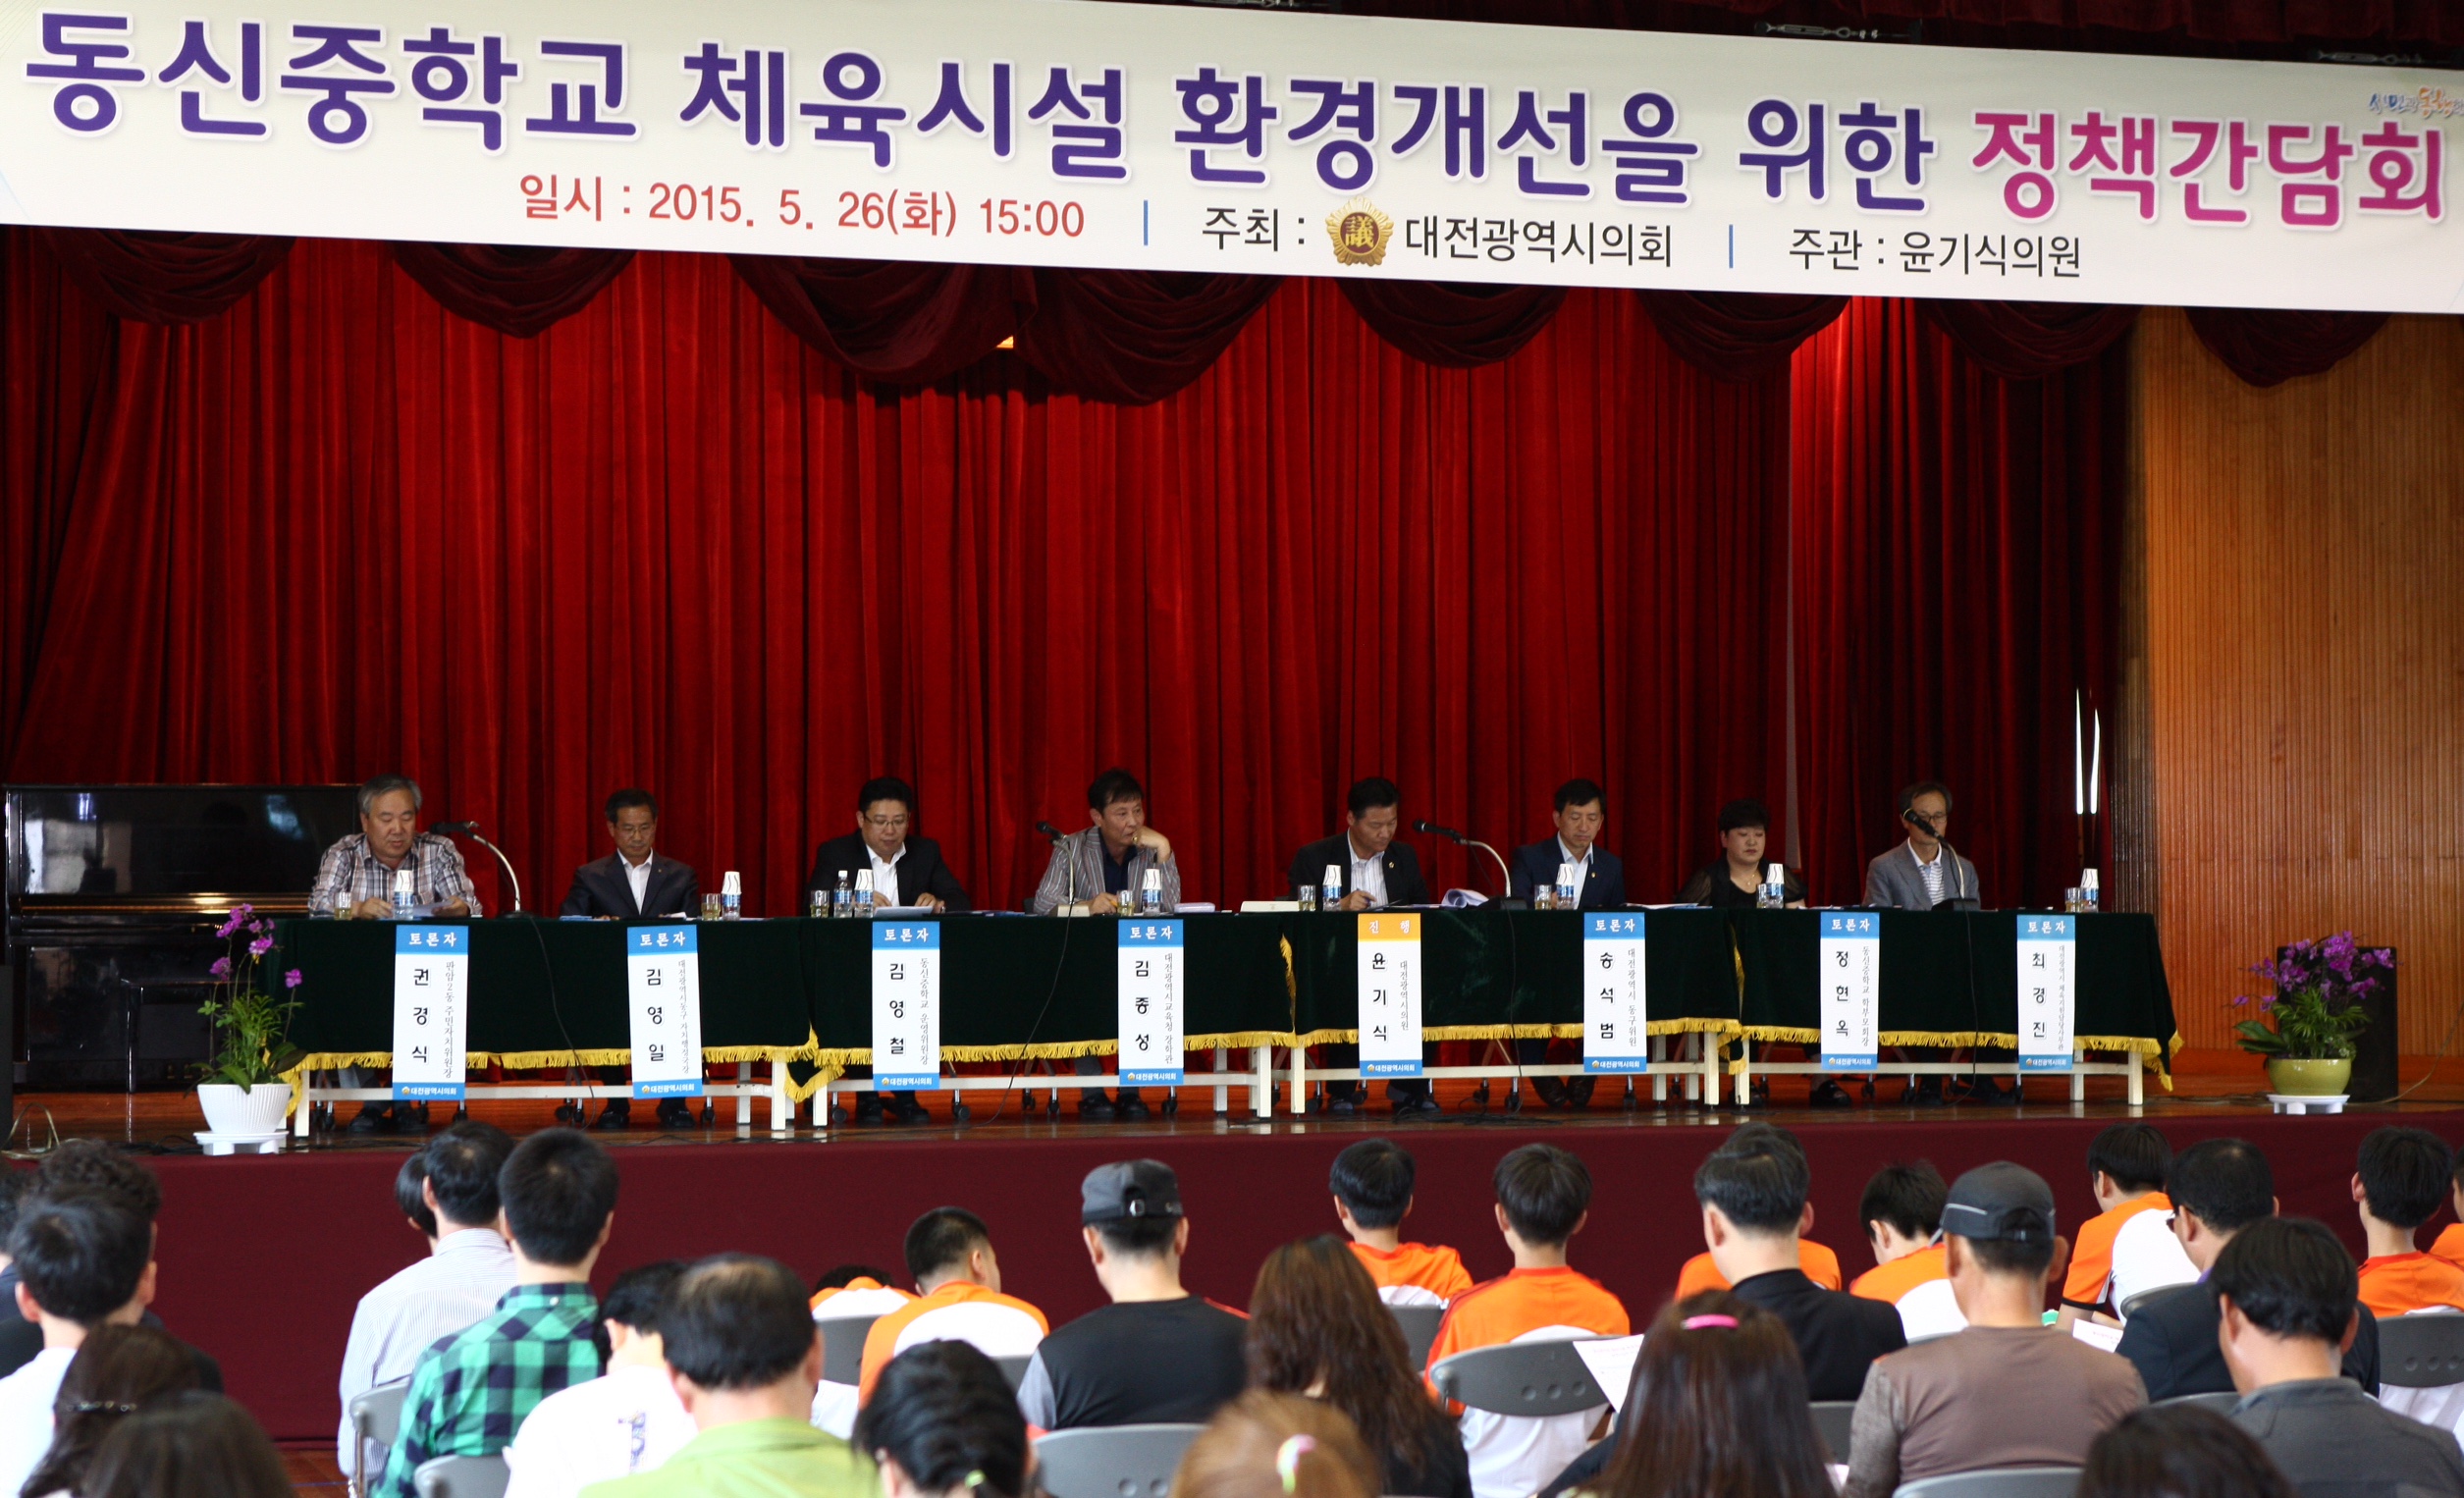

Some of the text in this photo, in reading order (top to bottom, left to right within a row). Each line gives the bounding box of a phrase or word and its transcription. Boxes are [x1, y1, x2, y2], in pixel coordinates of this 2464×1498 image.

[27, 13, 2442, 227] 동신중학교 체육시설 환경개선을 위한 정책간담회
[519, 174, 603, 223] 일시
[648, 181, 755, 228] 2015.
[778, 187, 815, 231] 5.
[837, 188, 957, 239] 26(화)
[980, 198, 1086, 239] 15:00
[1202, 207, 1280, 252] 주최
[1405, 214, 1672, 268] 대전광역시의회
[1788, 228, 1863, 271] 주관
[1899, 231, 2081, 279] 윤기식의원
[1595, 919, 1635, 933] 토론자
[1831, 918, 1870, 933] 토론자
[2027, 921, 2065, 935] 토론자
[408, 932, 457, 947] 토론자
[640, 932, 686, 946] 토론자
[884, 928, 929, 942] 토론자
[1130, 926, 1173, 940] 토론자
[445, 961, 455, 1003] 판암2동
[1375, 1063, 1416, 1072] 대전광역시의회
[1599, 1060, 1640, 1069] 대전광역시의회
[1835, 1057, 1872, 1066] 대전광역시의회
[889, 1077, 933, 1086] 대전광역시의회
[1135, 1072, 1177, 1081] 대전광역시의회
[650, 1084, 695, 1093] 대전광역시의회
